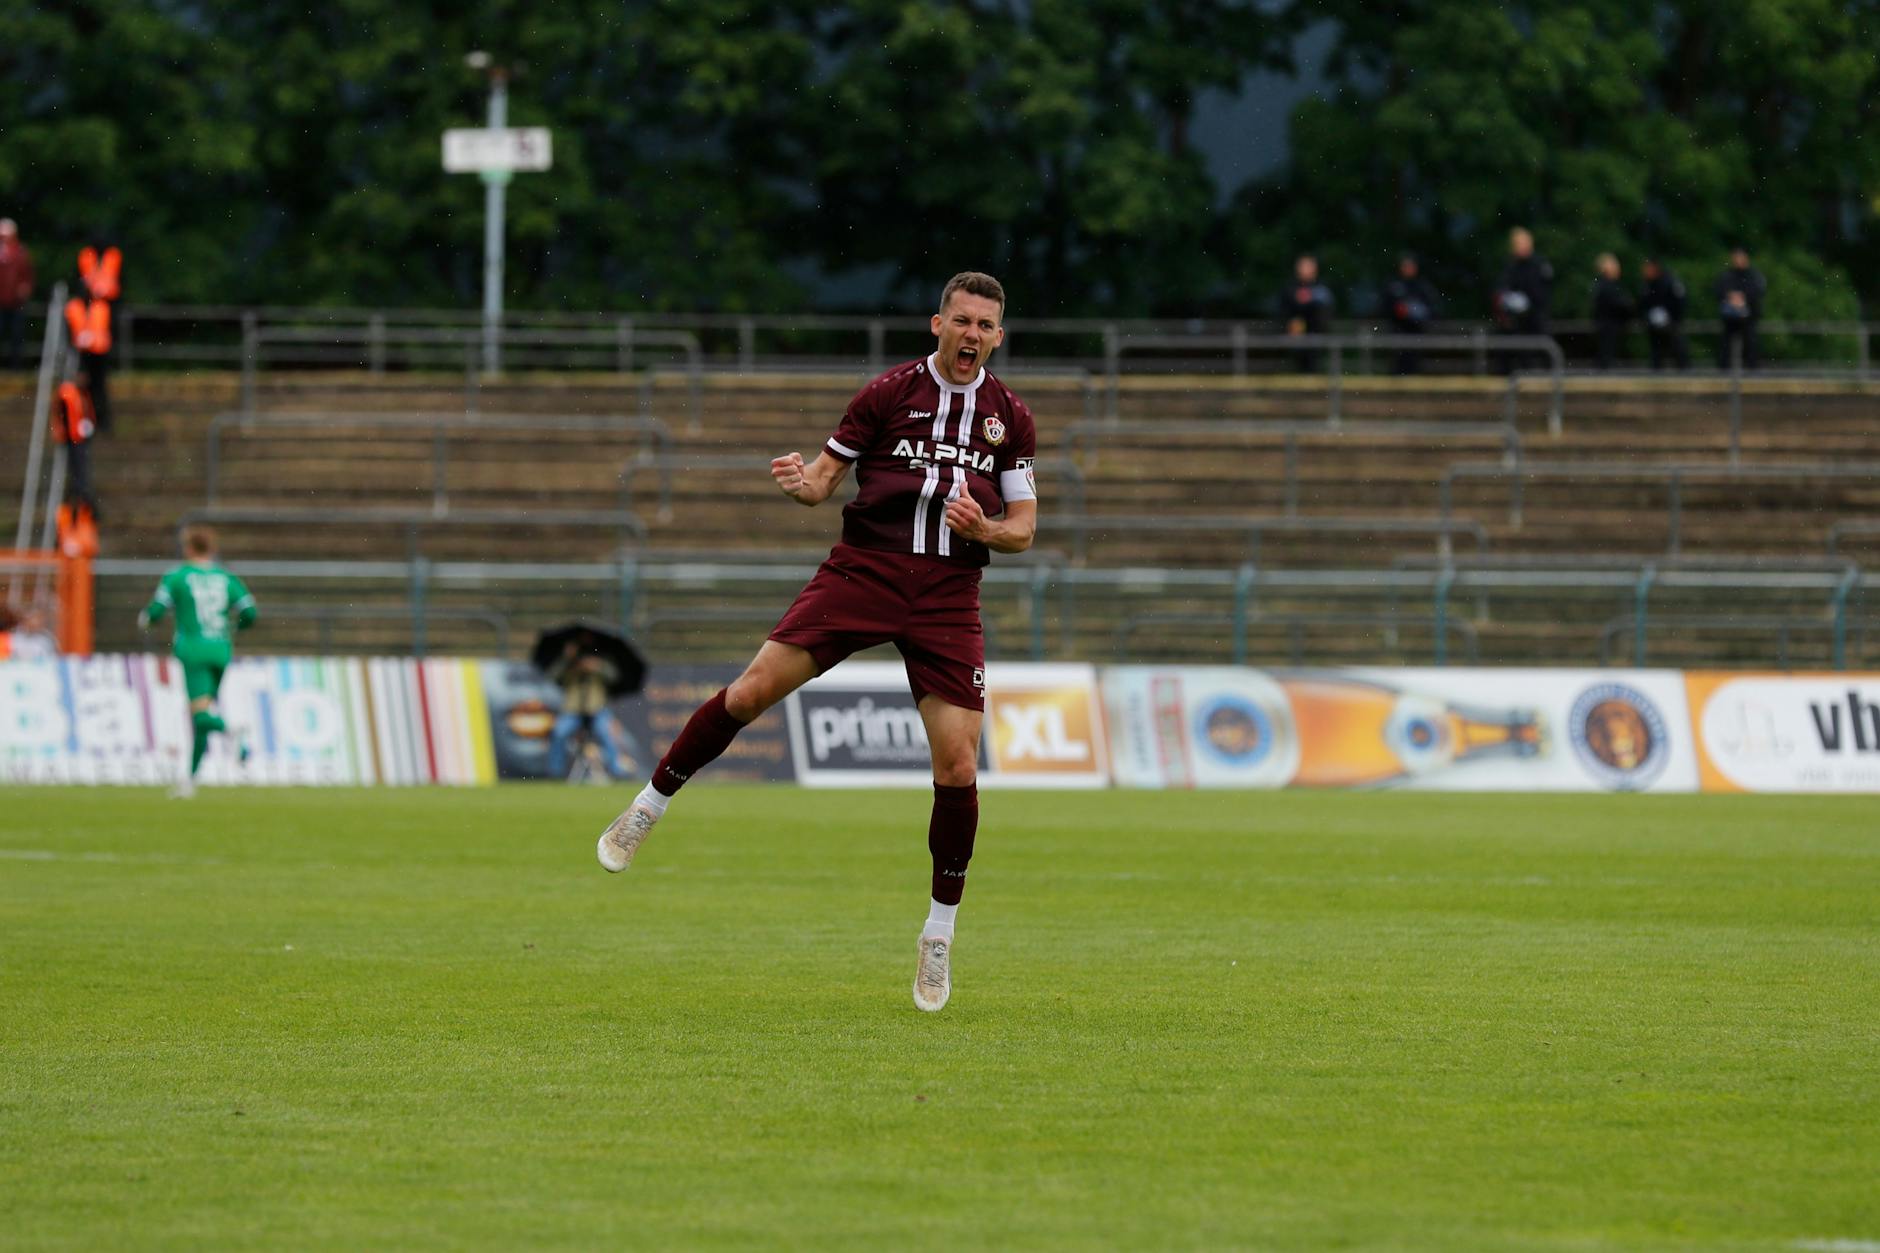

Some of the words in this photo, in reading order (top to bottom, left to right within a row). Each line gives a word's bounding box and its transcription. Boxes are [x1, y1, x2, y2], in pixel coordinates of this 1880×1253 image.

[892, 439, 994, 472] ALPHA
[808, 698, 928, 762] prim
[1001, 702, 1088, 760] XL
